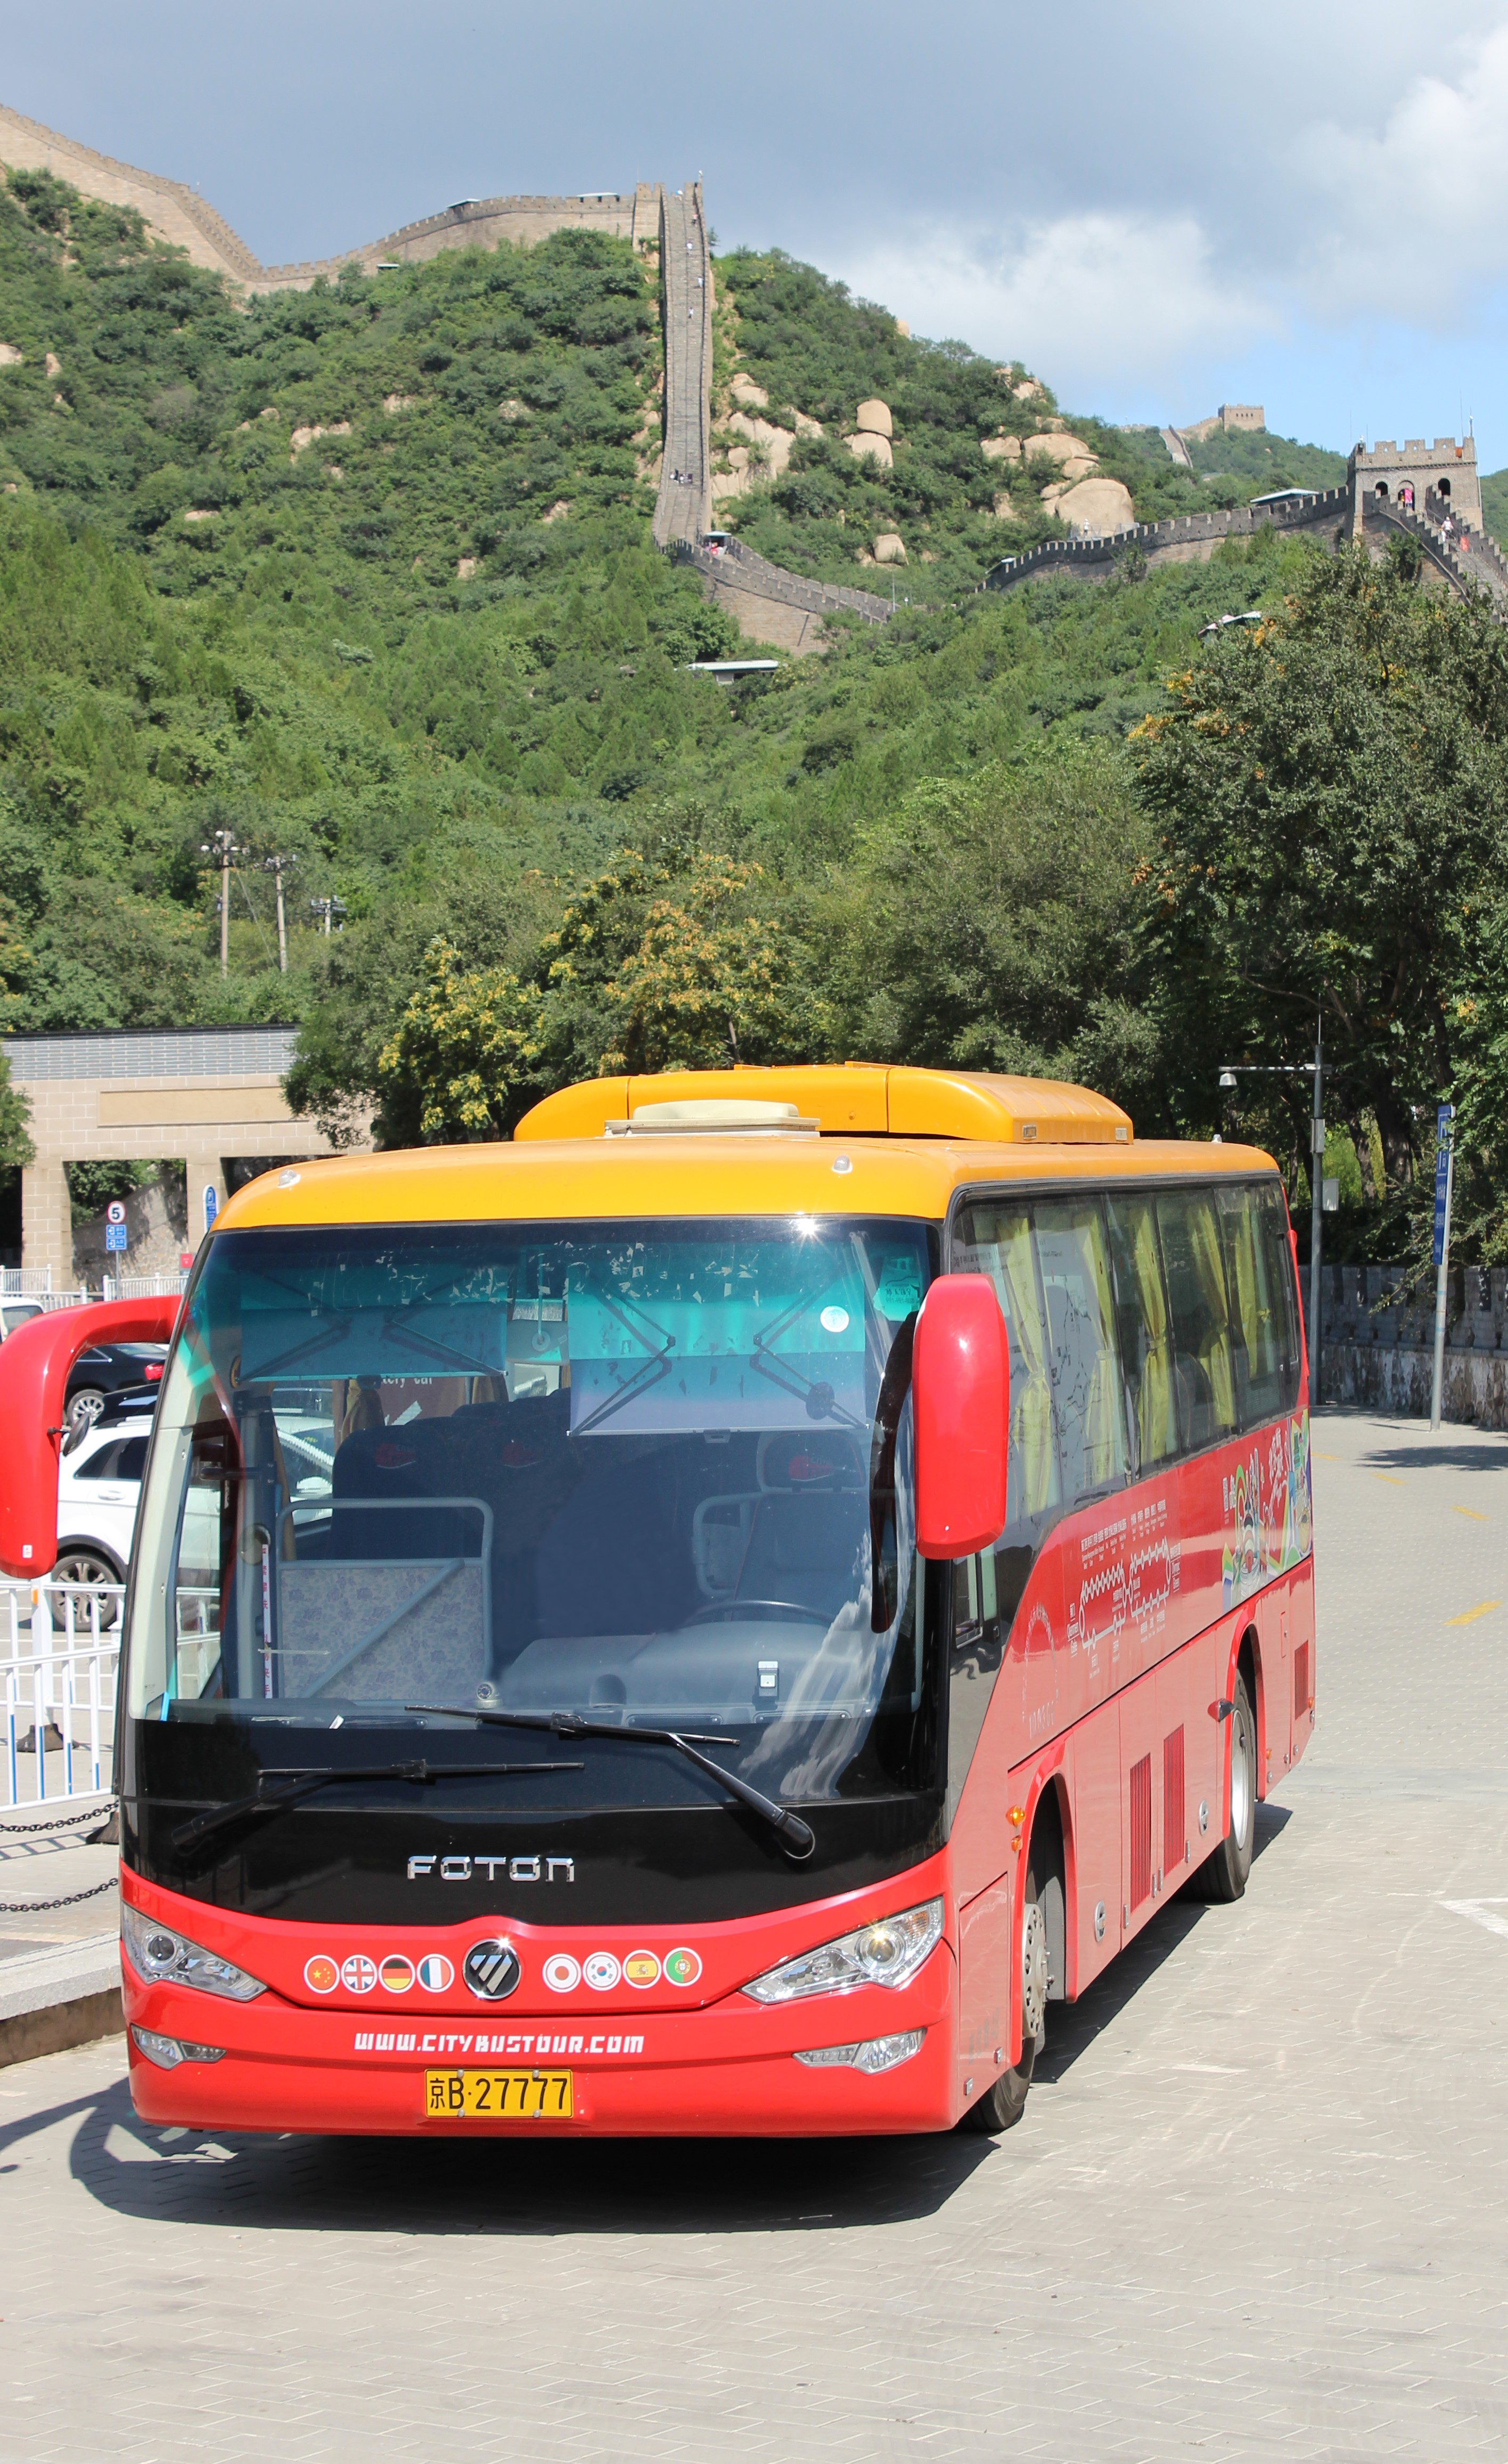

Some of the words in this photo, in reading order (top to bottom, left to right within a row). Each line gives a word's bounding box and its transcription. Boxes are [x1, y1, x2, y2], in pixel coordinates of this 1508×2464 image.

[112, 1207, 120, 1219] 5
[407, 1855, 575, 1882] FOTON
[354, 2033, 644, 2054] WWW.CITYBUSTOUR.COM
